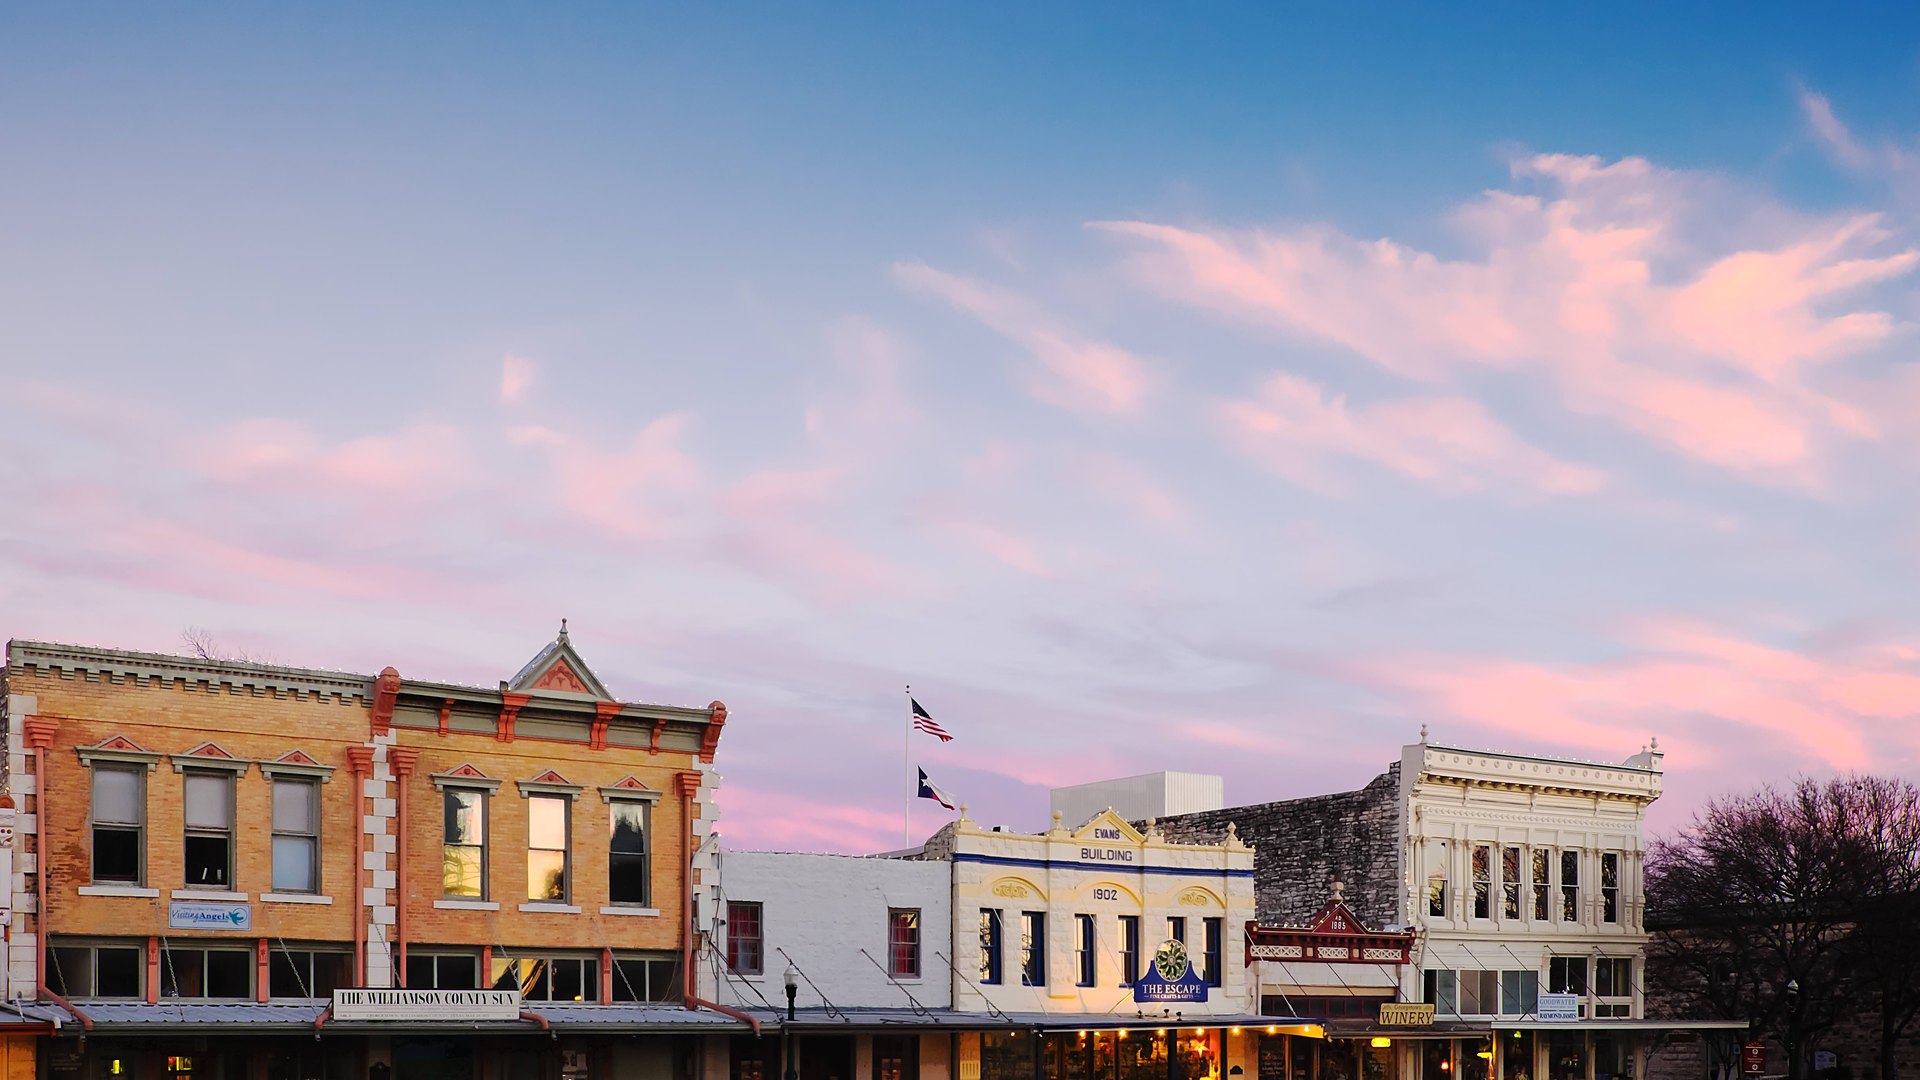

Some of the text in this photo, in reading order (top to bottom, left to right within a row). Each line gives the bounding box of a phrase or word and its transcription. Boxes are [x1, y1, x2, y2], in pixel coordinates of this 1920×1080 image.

[1095, 828, 1120, 839] EVANS
[1081, 848, 1133, 861] BUILDING
[1093, 889, 1118, 900] 1902
[172, 909, 229, 922] Visiting Angels
[1331, 921, 1346, 930] 1885
[1142, 984, 1201, 994] THE ESCAPE
[340, 992, 514, 1005] THE WILLIAMSON COUNTY SUN
[1381, 1011, 1433, 1024] WINERY
